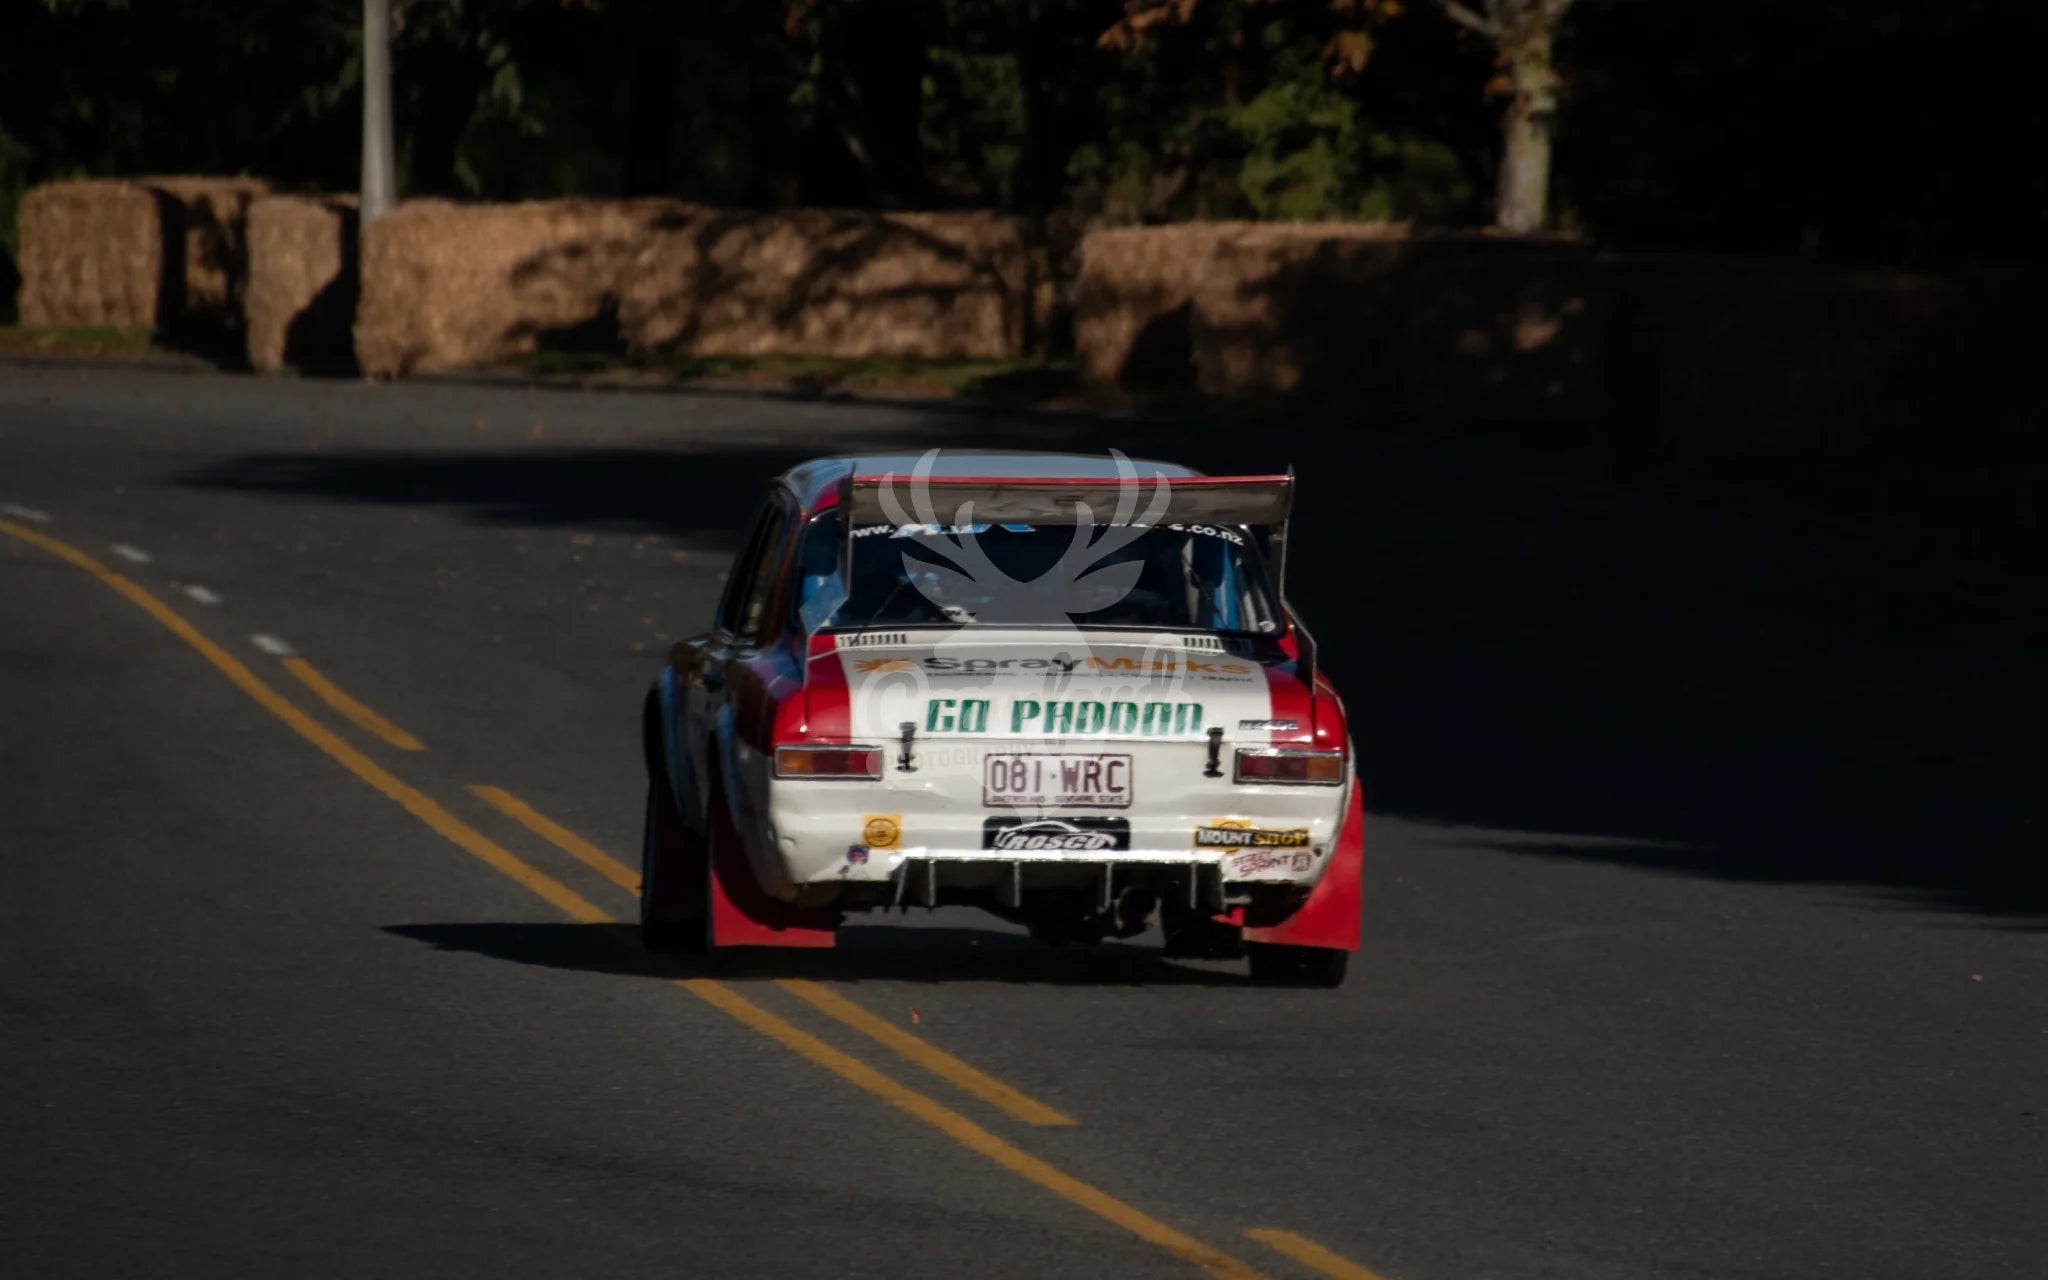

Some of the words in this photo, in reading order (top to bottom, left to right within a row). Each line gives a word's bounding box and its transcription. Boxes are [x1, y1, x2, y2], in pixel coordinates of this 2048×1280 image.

[923, 655, 1252, 675] SprayMarks
[925, 698, 990, 733] GO
[1010, 699, 1204, 736] PADDON
[1003, 834, 1108, 849] ROSCO
[1197, 829, 1252, 846] MOUNT
[1254, 832, 1306, 846] SHOP
